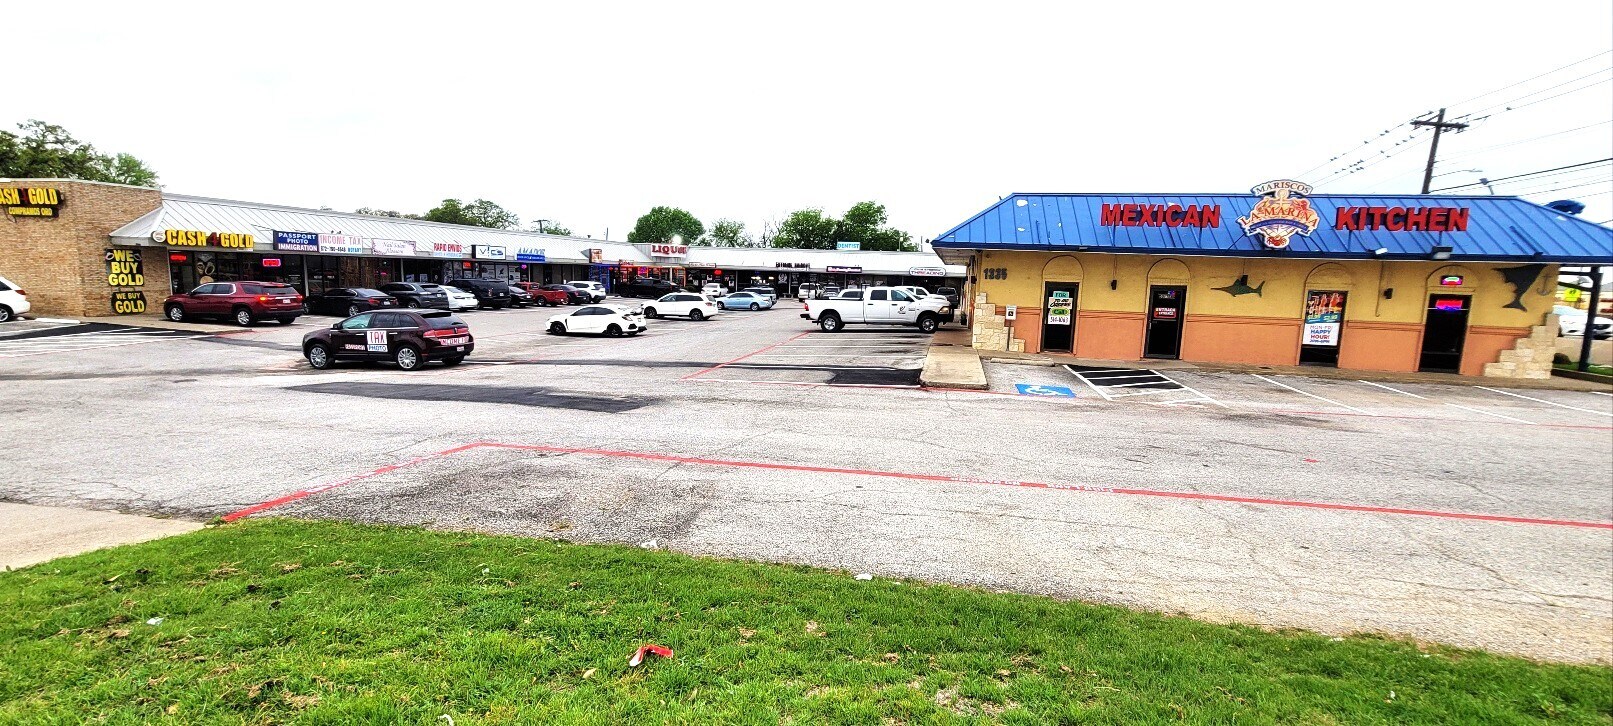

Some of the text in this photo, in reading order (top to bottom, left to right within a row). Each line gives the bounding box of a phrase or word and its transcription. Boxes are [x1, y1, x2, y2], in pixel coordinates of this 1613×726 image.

[1256, 181, 1311, 195] MARISCOS
[28, 188, 58, 204] GOLD
[1100, 203, 1221, 228] MEXICAN
[1240, 212, 1261, 226] LA
[1264, 206, 1319, 227] MARINA
[1336, 206, 1469, 232] KITCHEN
[166, 230, 206, 246] CASH
[220, 233, 254, 248] GOLD
[320, 235, 361, 245] INCOME TAX
[113, 250, 134, 261] WE
[111, 262, 138, 273] BUY
[108, 273, 144, 285] GOLD
[115, 300, 145, 313] GOLD
[370, 332, 385, 343] TAX
